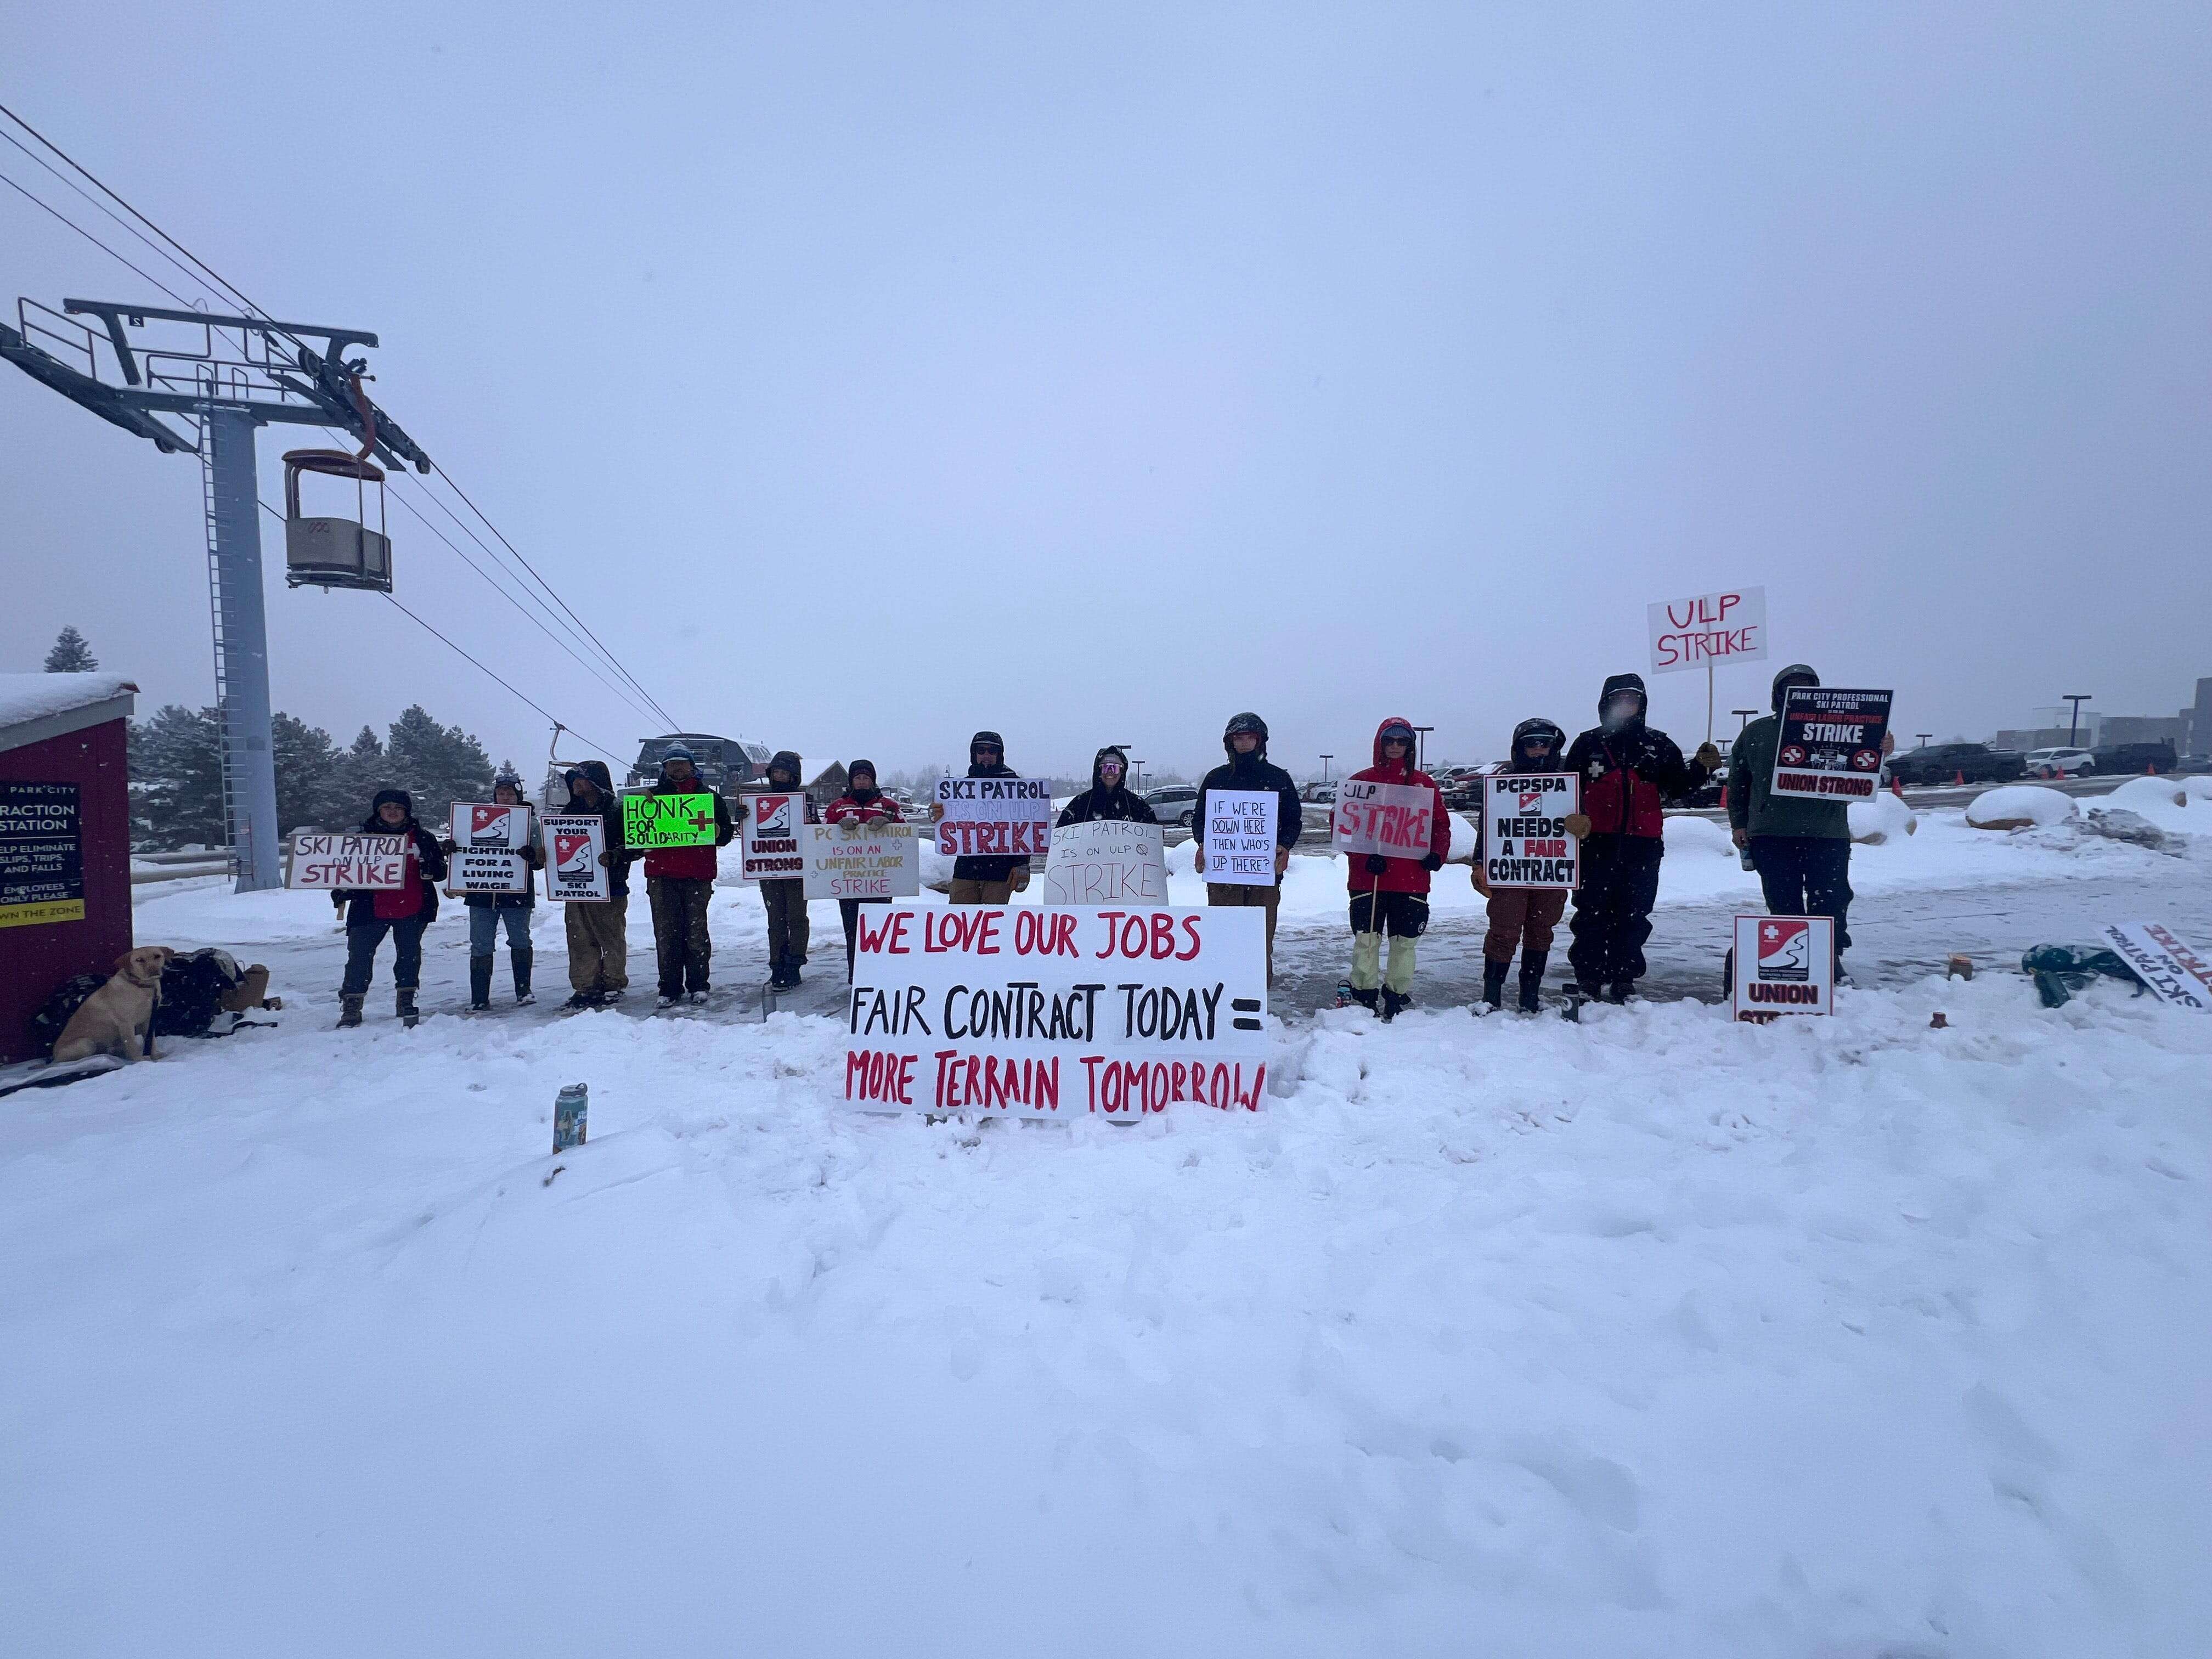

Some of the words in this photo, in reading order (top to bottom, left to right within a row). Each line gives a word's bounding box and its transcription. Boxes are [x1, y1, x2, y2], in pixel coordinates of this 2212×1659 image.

[1667, 594, 1740, 629] ULP
[1657, 626, 1758, 667] STRIKE
[1792, 692, 1812, 700] PARK
[1832, 693, 1888, 703] PROFESSIONAL
[1831, 701, 1859, 709] PATROL
[1803, 723, 1864, 743] STRIKE
[939, 781, 975, 799] SKI
[981, 781, 1050, 799] PATROL
[1345, 783, 1375, 799] ULP
[1496, 778, 1567, 793] PCPSPA
[1777, 773, 1818, 792] UNION
[1818, 776, 1874, 796] STRONG
[0, 805, 75, 816] RACTION
[627, 797, 695, 820] HONK
[947, 800, 970, 820] IS
[976, 801, 1002, 820] ON
[1009, 801, 1040, 820] ULP
[1214, 801, 1225, 814] IF
[1232, 802, 1266, 816] WE'RE
[627, 820, 657, 833] FOR
[1212, 820, 1239, 833] DOWN
[1244, 820, 1266, 834] HERE
[1338, 802, 1429, 848] STRIKE
[1497, 817, 1565, 838] NEEDS
[626, 832, 699, 845] SOLIDARITY
[814, 827, 833, 840] PC
[940, 821, 1049, 855] STRIKE
[1052, 825, 1080, 845] SKI
[1092, 822, 1156, 839] PATROL
[20, 844, 76, 853] ELIMINATE
[295, 837, 332, 856] SKI
[341, 836, 405, 856] PATROL
[453, 847, 517, 855] FIGHTIN
[752, 839, 797, 853] UNION
[833, 847, 843, 856] IS
[847, 846, 862, 855] ON
[867, 845, 881, 854] AN
[1061, 849, 1077, 858] IS
[1086, 847, 1099, 856] ON
[1109, 845, 1131, 854] ULP
[1212, 838, 1235, 850] THEN
[1241, 839, 1270, 851] WHO'S
[1502, 840, 1514, 856] A
[1524, 839, 1567, 857] FAIR
[4, 865, 29, 873] AND
[31, 863, 62, 872] FALLS
[332, 856, 352, 866] ON
[357, 856, 382, 865] ULP
[746, 857, 803, 872] STRONG
[816, 856, 866, 870] UNFAIR
[868, 855, 904, 868] LABOR
[1213, 857, 1227, 868] UP
[1231, 857, 1270, 872] THERE?
[301, 863, 402, 885] STRIKE
[462, 870, 514, 878] LIVING
[1488, 859, 1575, 882] CONTRACT
[4, 883, 65, 894] EMPLOYEES
[831, 878, 891, 895] STRIKE
[1048, 863, 1159, 905] STRIKE
[32, 891, 69, 901] PLEASE
[23, 909, 46, 918] THE
[50, 906, 81, 916] ZONE
[860, 912, 915, 953] WE
[924, 910, 1005, 955] LOVE
[1015, 911, 1079, 958] OUR
[1096, 912, 1201, 961] JOBS
[2142, 924, 2212, 996] TRIKE
[1748, 983, 1818, 1004] UNION
[851, 985, 932, 1035] FAIR
[944, 983, 1106, 1042] CONTRACT
[1118, 982, 1224, 1041] TODAY
[845, 1049, 918, 1105] MORE
[934, 1050, 1059, 1111] TERRAIN
[1079, 1056, 1266, 1115] TOMORROW
